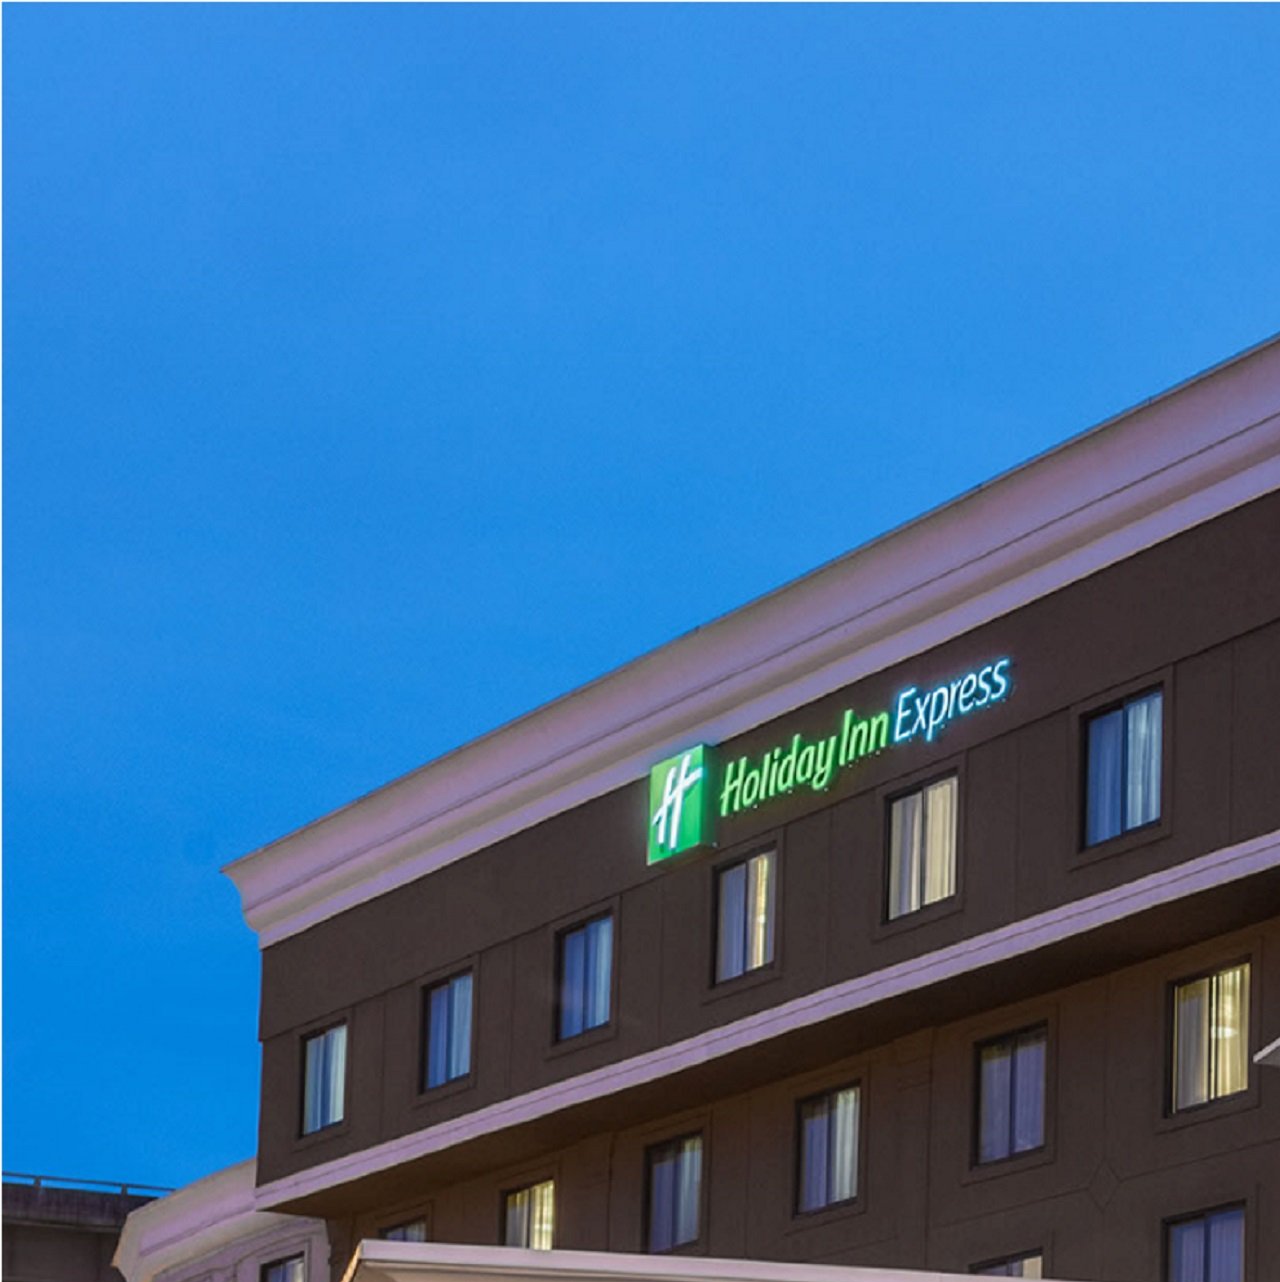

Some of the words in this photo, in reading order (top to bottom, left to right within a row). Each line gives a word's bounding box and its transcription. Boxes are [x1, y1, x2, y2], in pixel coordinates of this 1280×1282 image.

[721, 733, 838, 816] Holiday
[838, 709, 890, 768] Inn
[893, 658, 1010, 742] Express
